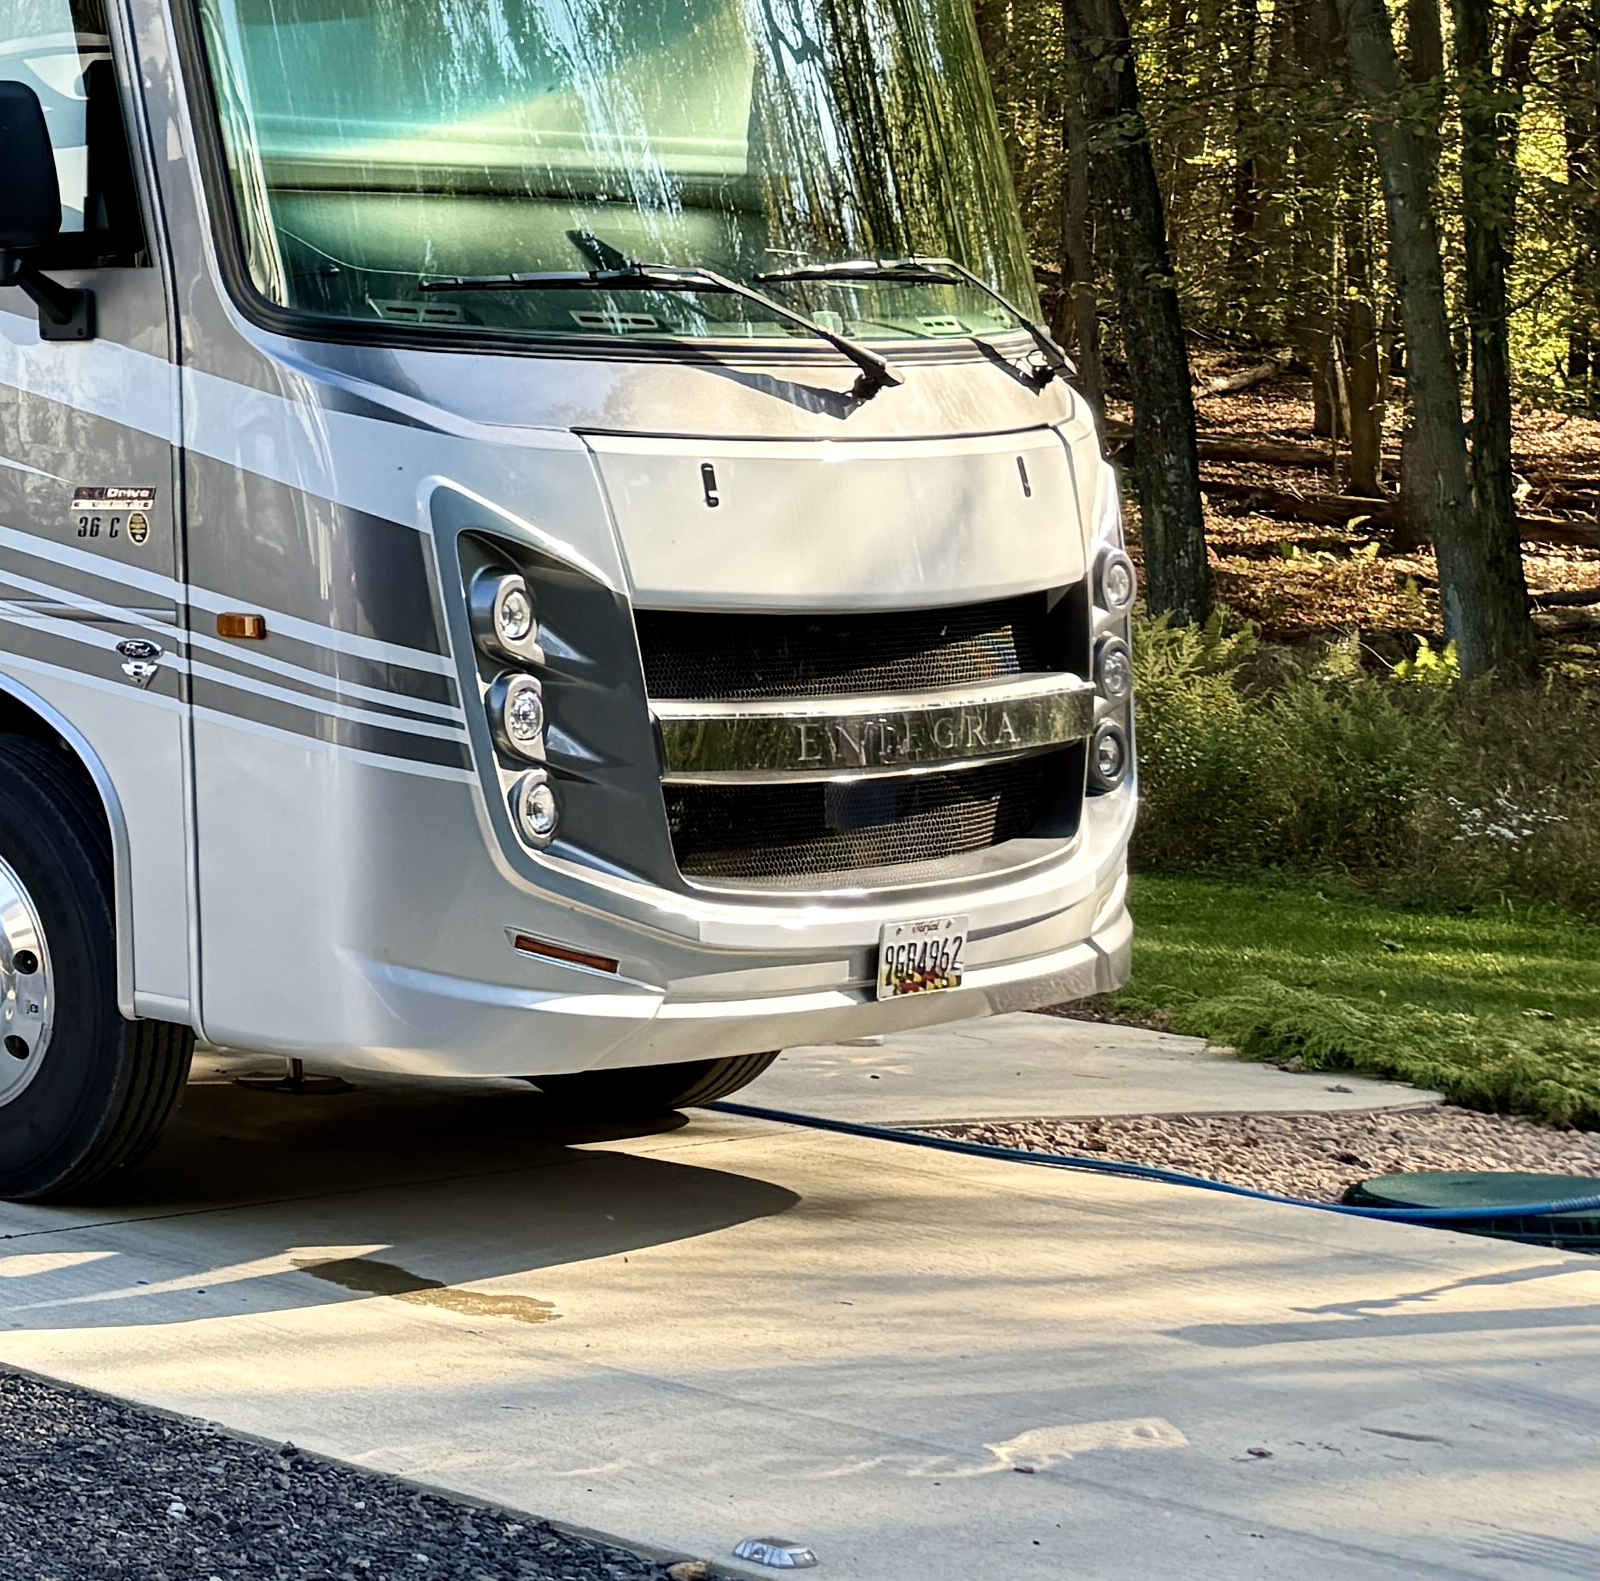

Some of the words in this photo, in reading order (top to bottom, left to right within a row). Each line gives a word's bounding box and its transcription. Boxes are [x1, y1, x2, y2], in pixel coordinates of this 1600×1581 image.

[106, 488, 150, 498] Drive
[78, 516, 101, 538] 36
[109, 516, 121, 538] C
[797, 711, 1021, 767] ENTEGRA
